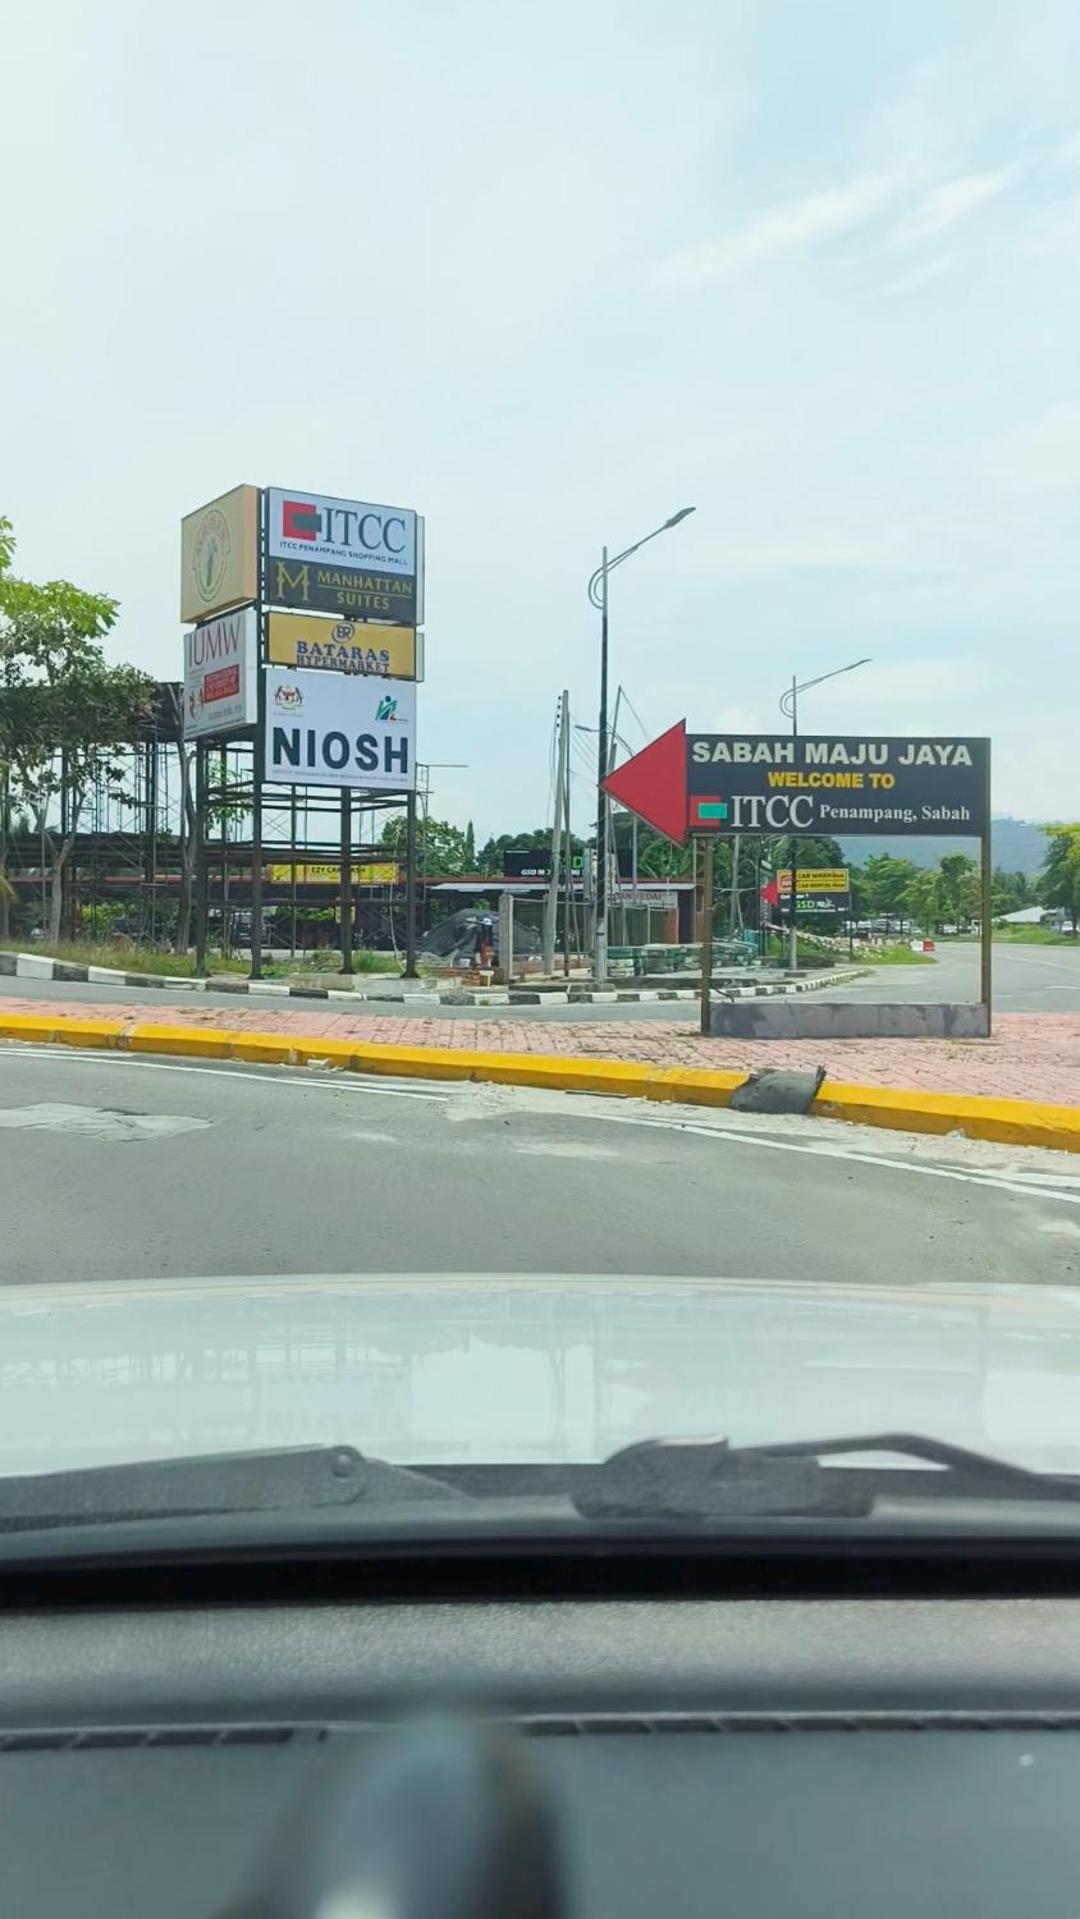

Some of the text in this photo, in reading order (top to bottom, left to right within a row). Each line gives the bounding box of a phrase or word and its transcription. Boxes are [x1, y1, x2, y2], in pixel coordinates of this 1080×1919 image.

[323, 507, 406, 553] ITCC
[279, 541, 408, 566] ITCC PENAMPANG SHOPPING MALL
[317, 570, 412, 595] MANHATTAN
[337, 591, 390, 610] SUITES
[189, 615, 241, 668] IUMW
[296, 640, 390, 663] BATARAS
[296, 655, 390, 673] HYPERMARKET
[273, 727, 408, 774] NIOSH
[692, 741, 973, 766] SABAH MAJU JAYA
[767, 771, 895, 789] WELCOME TO
[731, 795, 814, 828] ITCC
[819, 804, 971, 823] Penampang, Sabah
